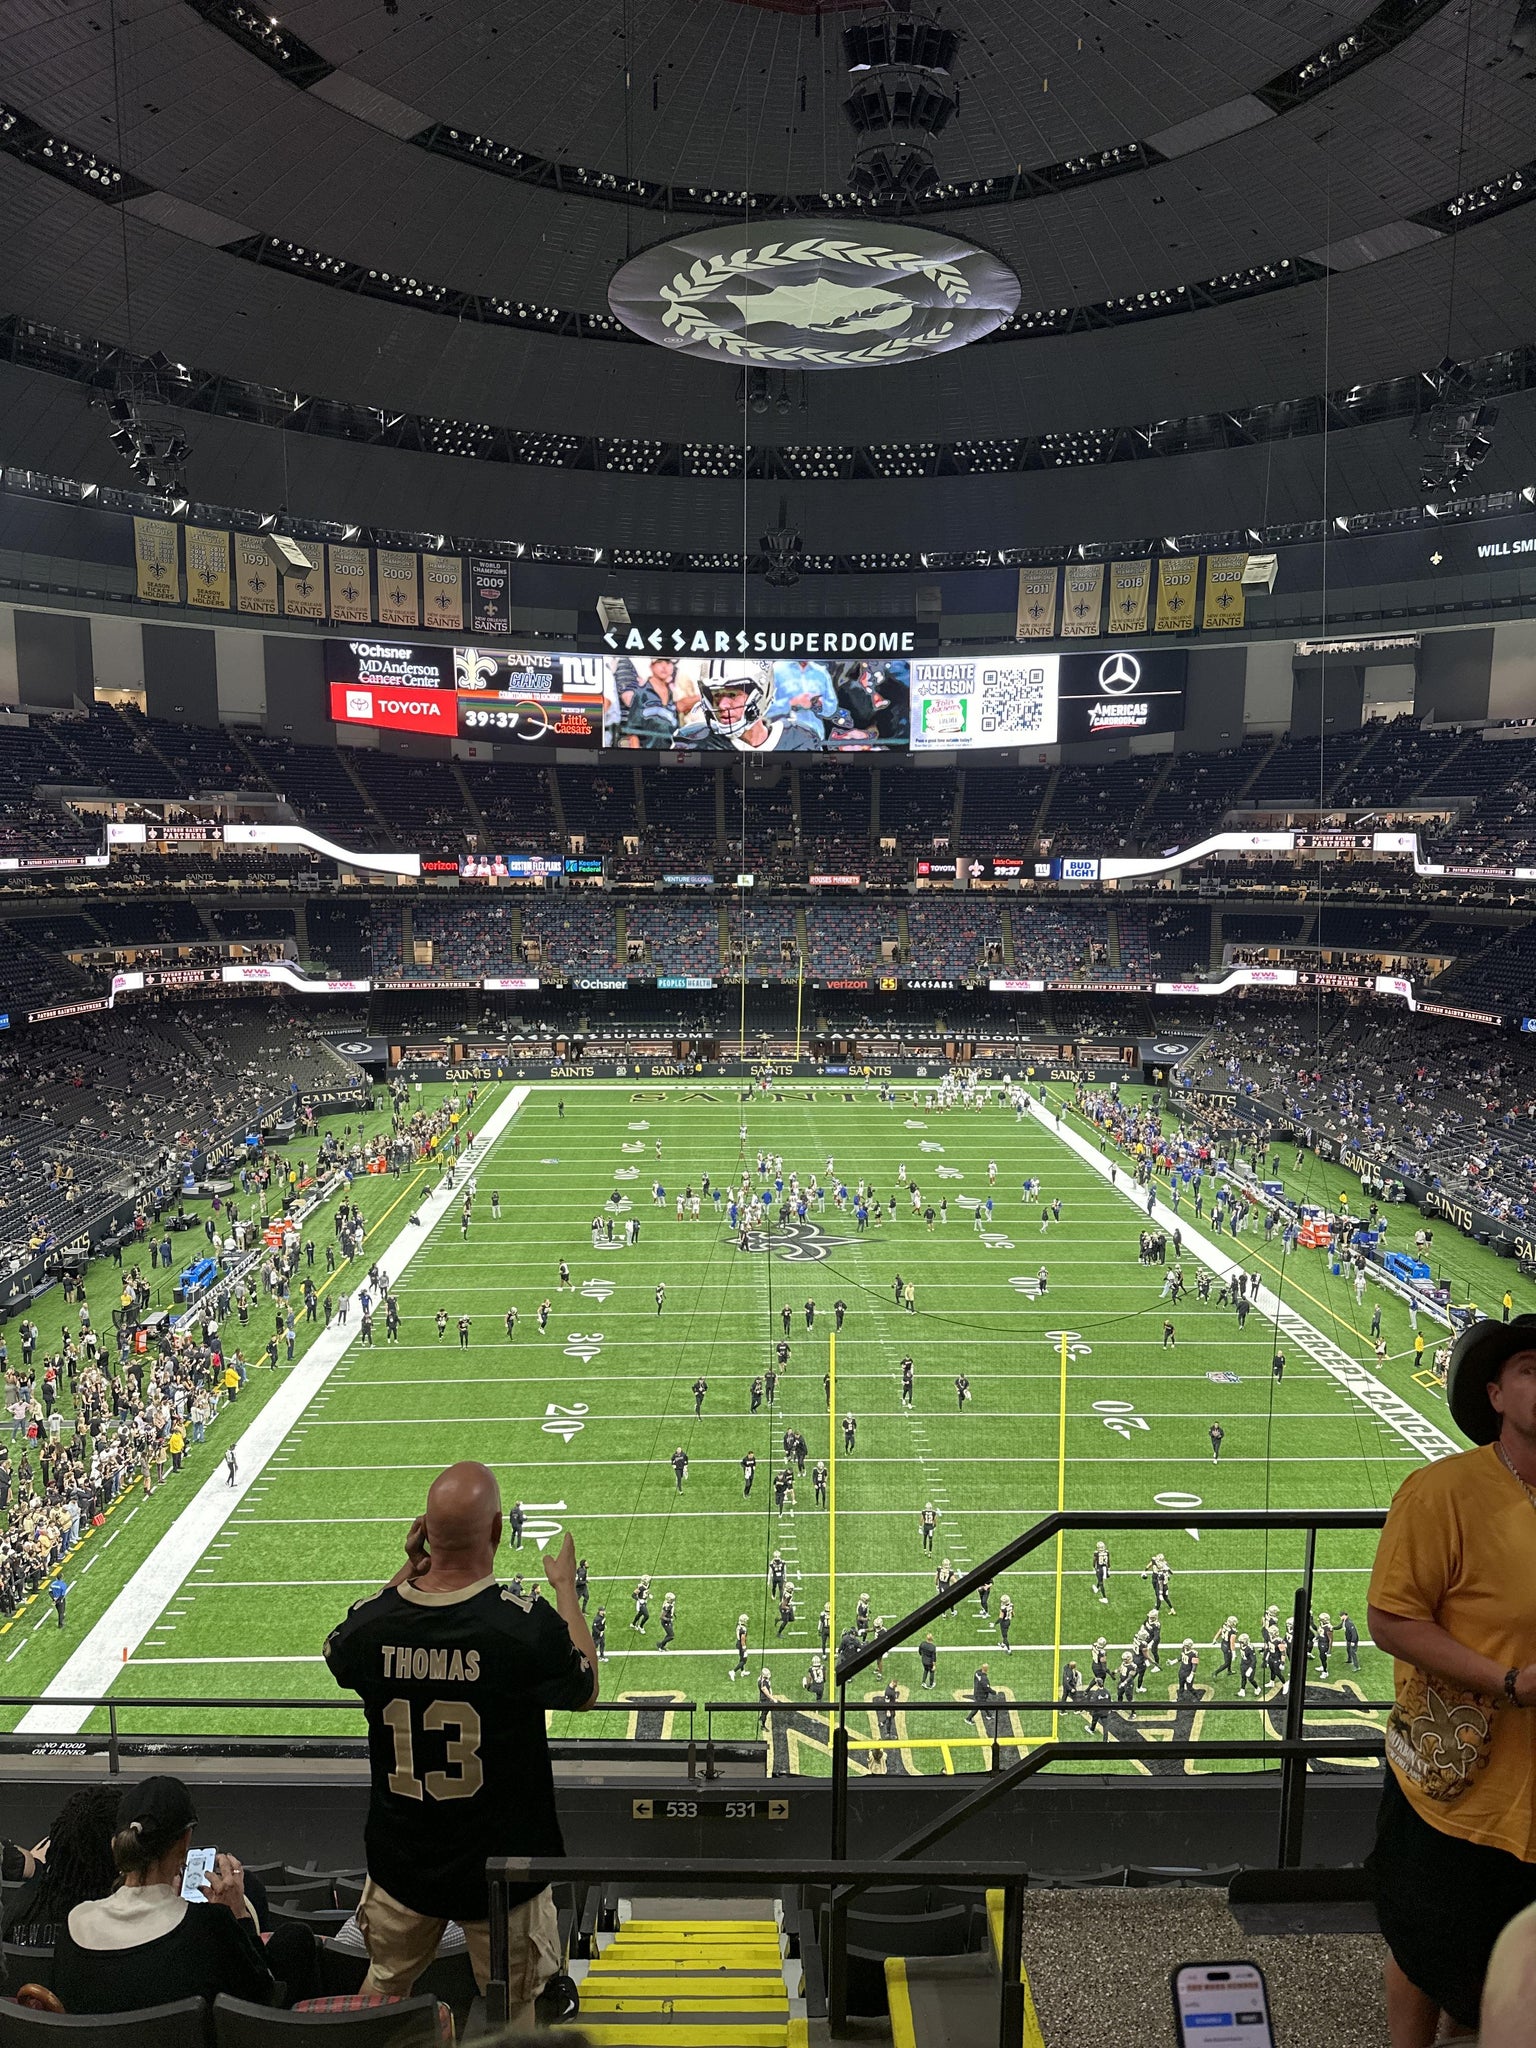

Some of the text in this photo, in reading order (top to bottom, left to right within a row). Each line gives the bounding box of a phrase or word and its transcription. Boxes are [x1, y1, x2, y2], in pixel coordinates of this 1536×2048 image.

[1477, 543, 1511, 558] WILL
[243, 553, 269, 566] 1991
[335, 563, 364, 576] 2006
[383, 568, 413, 580] 2009
[473, 566, 507, 575] CHAMPIONS
[428, 572, 457, 584] 2009
[476, 576, 504, 588] 2009
[1164, 574, 1191, 586] 2019
[1212, 571, 1242, 582] 2020
[147, 581, 170, 589] SEASON
[1026, 584, 1049, 594] 2011
[1071, 581, 1096, 592] 2017
[1117, 578, 1143, 589] 2018
[143, 591, 174, 600] HOLDERS
[192, 597, 225, 607] HOLDERS
[240, 601, 276, 613] SAINTS
[287, 604, 323, 617] SAINTS
[333, 609, 368, 621] SAINTS
[382, 613, 416, 624] SAINTS
[427, 616, 460, 628] SAINTS
[1205, 617, 1241, 628] SAINTS
[474, 620, 508, 631] SAINTS
[1064, 625, 1097, 635] SAINTS
[1110, 621, 1145, 632] SAINTS
[1157, 619, 1192, 630] SAINTS
[1019, 627, 1051, 636] SAINTS
[603, 627, 915, 653] CAESARS SUPERDOME
[357, 643, 413, 660] Ochsner
[507, 654, 552, 668] SAINTS
[359, 659, 440, 677] MD Anderson
[916, 663, 976, 680] TAILGATE
[358, 671, 440, 688] Cancer Center
[509, 672, 553, 690] GIANTS
[928, 679, 975, 695] SEASON
[378, 700, 441, 716] TOYOTA
[1088, 702, 1148, 718] AMERICAS
[465, 711, 519, 728] 39:37
[561, 714, 588, 725] Little
[554, 722, 592, 735] Caesars
[421, 860, 458, 871] verizon
[533, 861, 545, 871] FLEX
[545, 861, 562, 871] PLANS
[994, 866, 1020, 876] 39:37
[1070, 861, 1091, 870] BUD
[123, 874, 150, 882] SAINTS
[185, 873, 214, 881] SAINTS
[1065, 868, 1095, 878] LIGHT
[8, 878, 32, 886] SAINTS
[64, 875, 91, 883] SAINTS
[1229, 878, 1257, 886] SAINTS
[1291, 879, 1318, 887] SAINTS
[1352, 881, 1379, 889] SAINTS
[1413, 882, 1439, 891] SAINTS
[1469, 884, 1496, 893] SAINTS
[161, 974, 205, 984] PARTNERS
[581, 979, 627, 989] Ochsner
[658, 979, 712, 988] PEOPLES HEALTH
[724, 977, 749, 985] SAINTS
[781, 977, 806, 985] SAINTS
[827, 980, 868, 989] verizon
[882, 979, 896, 989] 25
[907, 980, 954, 989] CAESARS
[1315, 978, 1359, 987] PARTNERS
[37, 1002, 102, 1019] PATRON SAINTS PARTNERS
[1423, 1005, 1493, 1022] PATRON SAINTS PARTNERS
[551, 1067, 594, 1077] SAINTS
[849, 1066, 892, 1076] SANTS
[1051, 1070, 1096, 1081] SAINS
[302, 1089, 364, 1105] SAINTS
[631, 1091, 916, 1103] SAINTS
[1344, 1150, 1381, 1177] SAINTS
[1426, 1192, 1473, 1230] SAINTS
[979, 1233, 1016, 1249] 50
[580, 1278, 617, 1298] 40
[563, 1332, 605, 1357] 30
[1045, 1331, 1093, 1355] 30
[1270, 1313, 1454, 1457] INTERCEPT CANCER
[541, 1402, 590, 1434] 20
[1092, 1400, 1151, 1431] 20
[521, 1499, 568, 1539] 10
[924, 1514, 933, 1523] 12
[381, 1645, 481, 1682] THOMAS
[59, 1742, 86, 1750] FOOD
[382, 1698, 484, 1801] 13
[666, 1802, 756, 1818] 533 531
